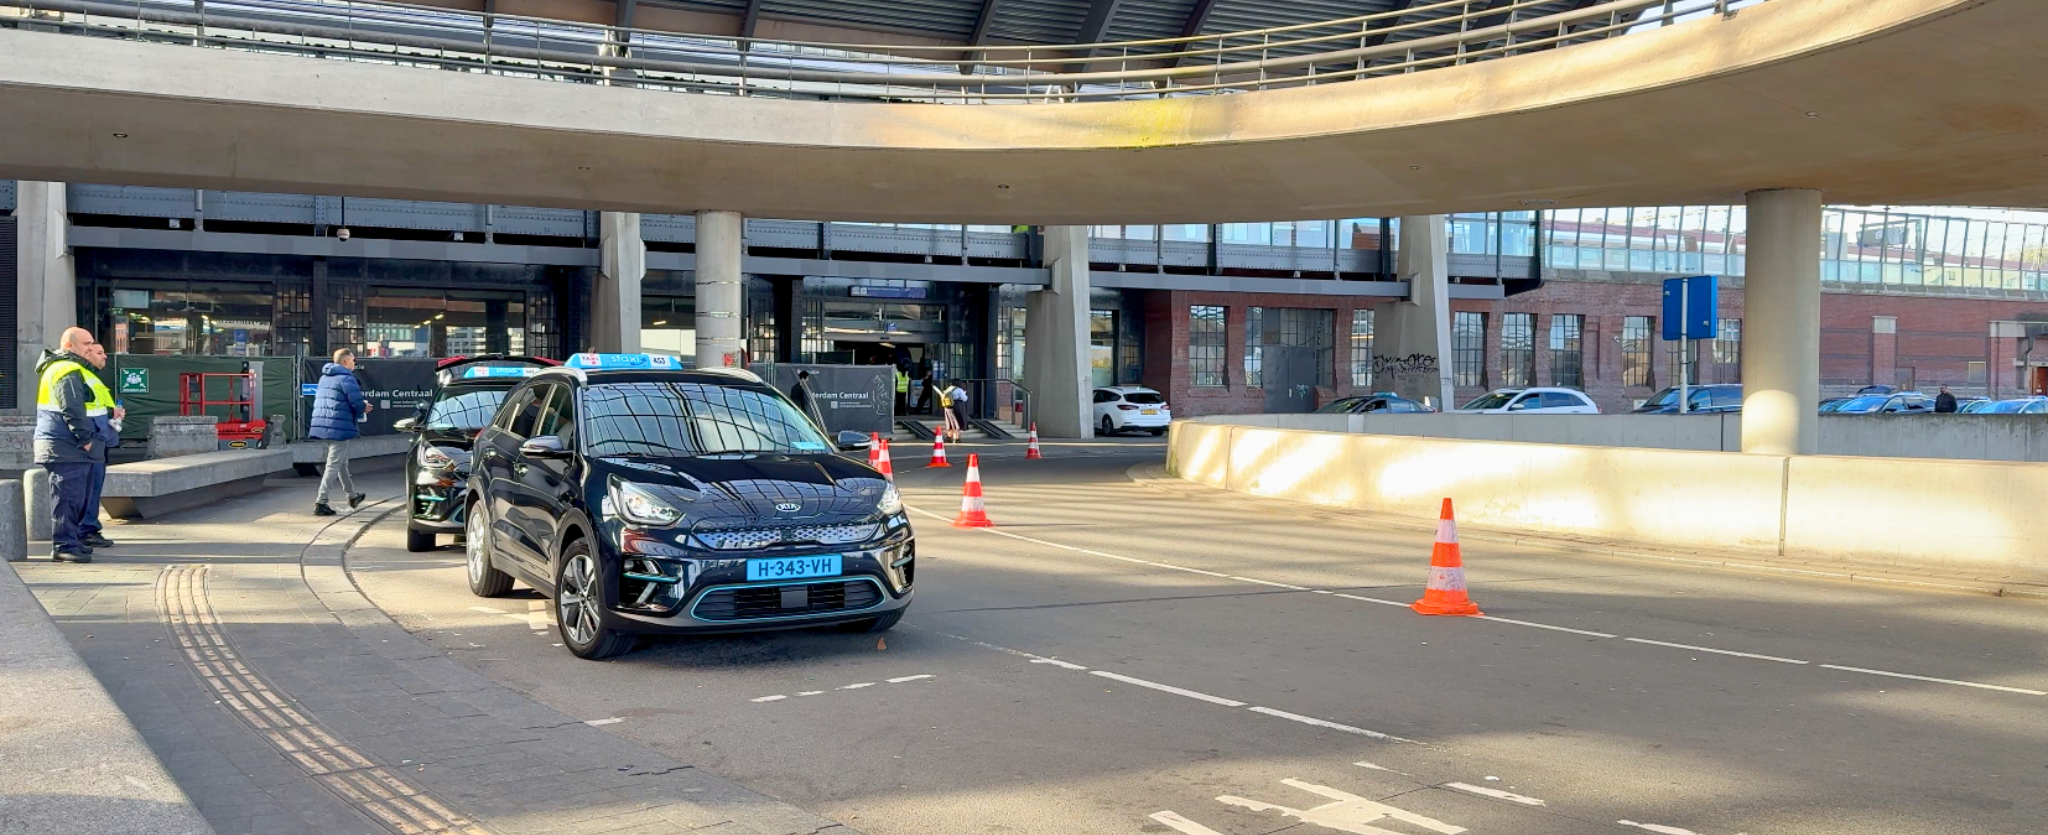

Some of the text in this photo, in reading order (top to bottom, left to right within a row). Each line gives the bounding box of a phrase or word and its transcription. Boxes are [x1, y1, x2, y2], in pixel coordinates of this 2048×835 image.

[611, 354, 640, 363] staxi
[361, 389, 433, 398] erdam Centraal
[839, 391, 869, 399] Centraal
[777, 503, 799, 511] KIA
[758, 558, 832, 577] H-343-VH
